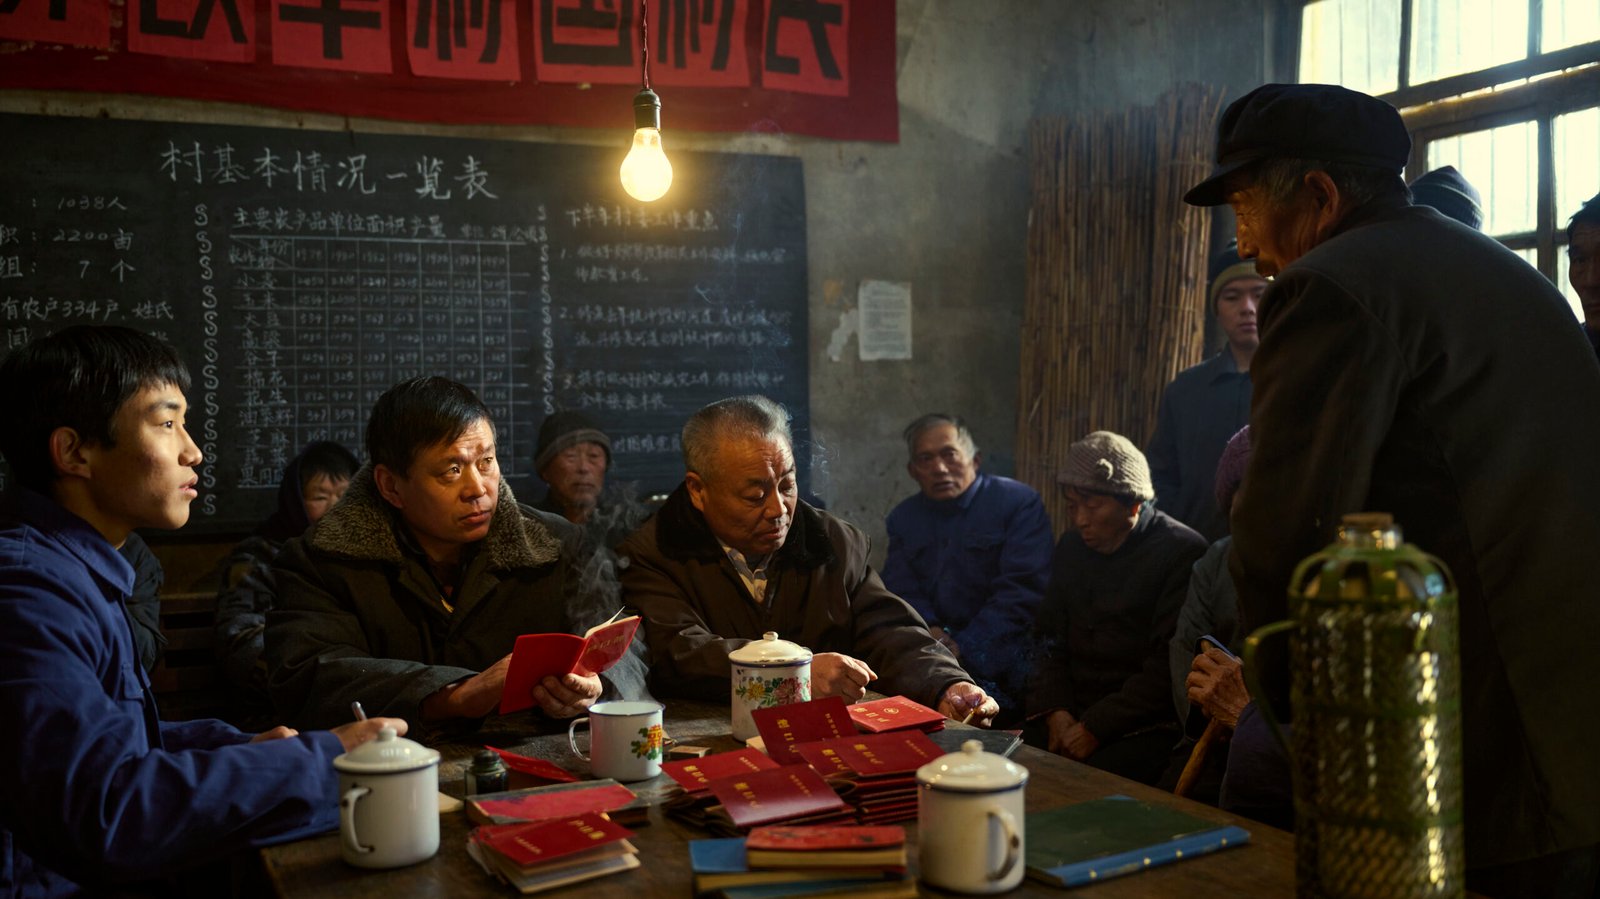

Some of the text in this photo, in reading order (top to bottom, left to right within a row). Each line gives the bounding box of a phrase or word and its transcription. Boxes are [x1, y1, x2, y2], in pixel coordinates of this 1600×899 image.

[160, 140, 498, 201] 村基本情况一览表
[52, 228, 135, 252] 2200亩
[79, 260, 92, 279] 7
[111, 258, 138, 284] 个
